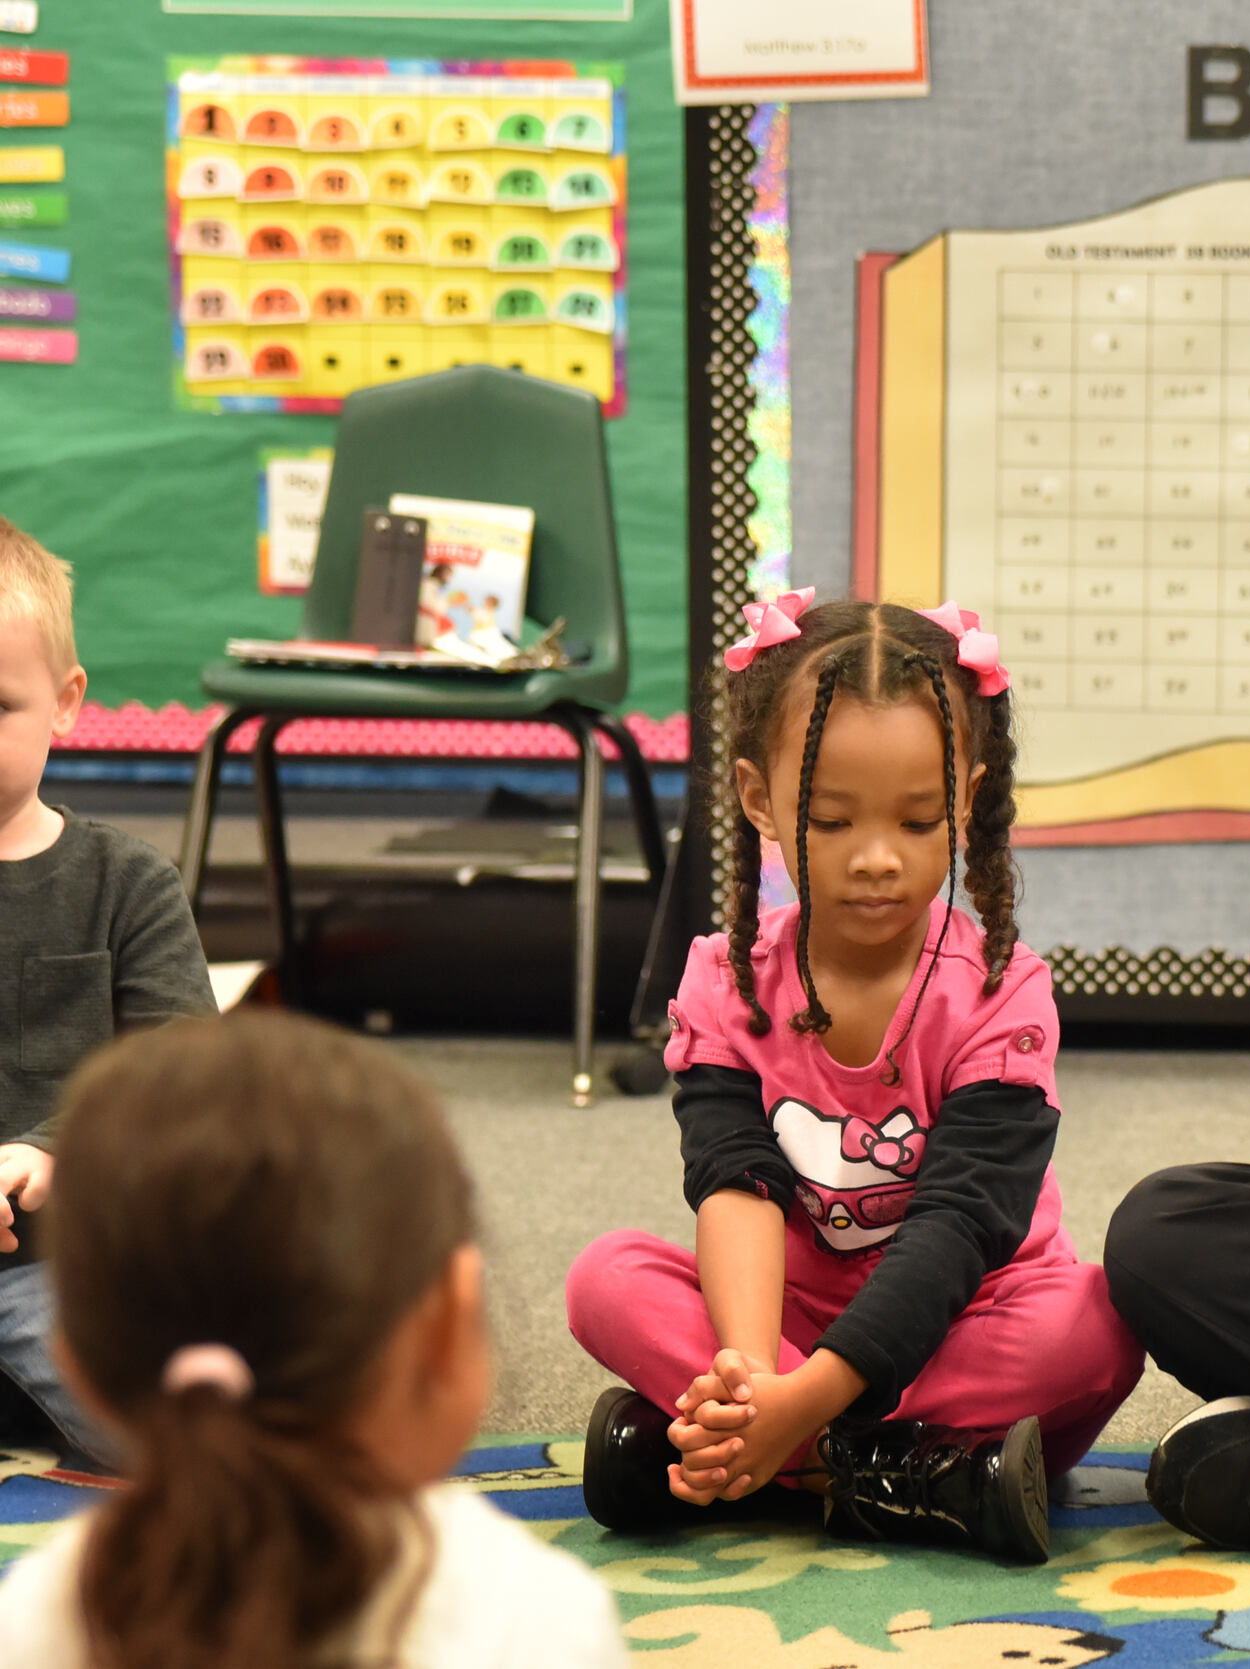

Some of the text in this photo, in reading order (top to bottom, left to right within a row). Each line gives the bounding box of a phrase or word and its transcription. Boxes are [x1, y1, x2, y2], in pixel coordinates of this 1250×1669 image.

[203, 105, 218, 135] 1
[515, 119, 531, 139] 6
[1045, 244, 1079, 261] OLD
[1084, 243, 1176, 261] TESTAMENT
